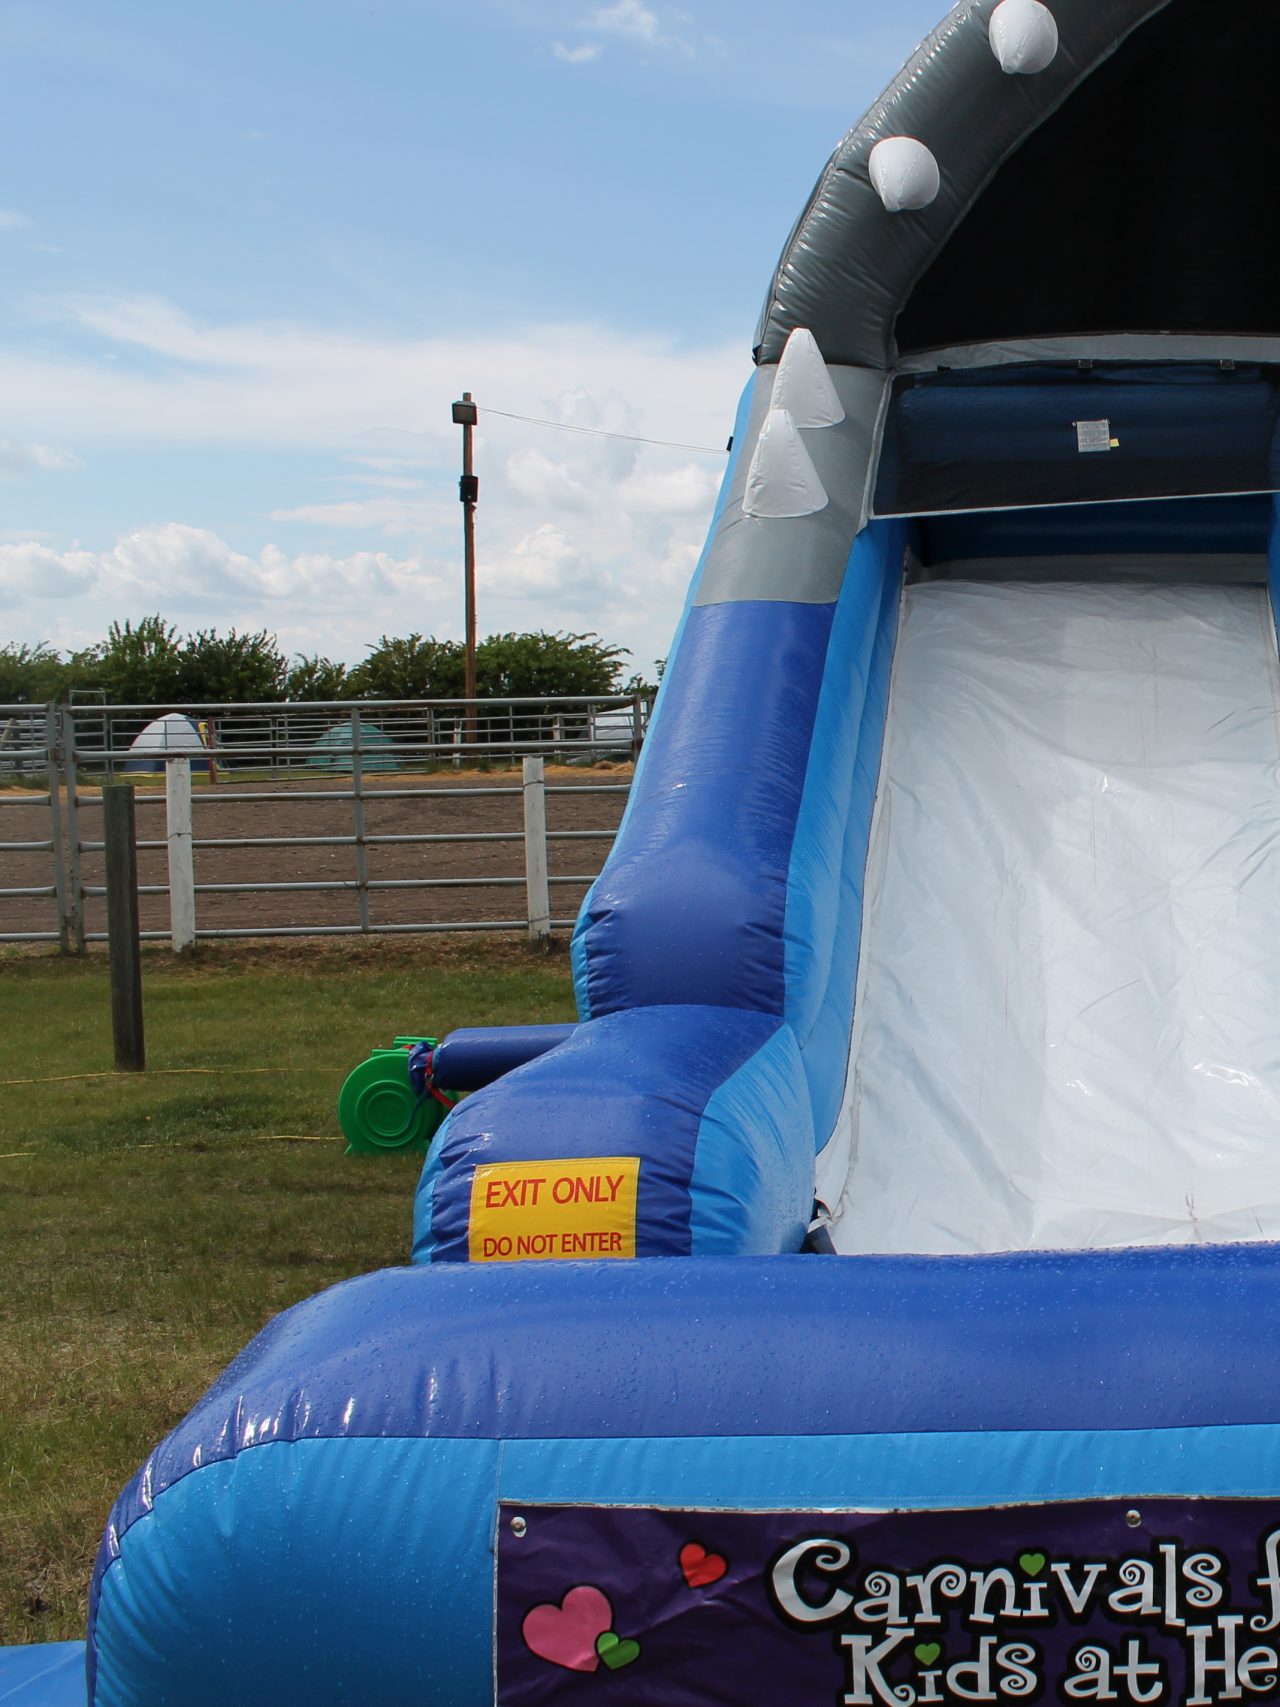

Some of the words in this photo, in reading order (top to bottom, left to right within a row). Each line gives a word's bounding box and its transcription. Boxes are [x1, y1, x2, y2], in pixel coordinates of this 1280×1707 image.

[485, 1178, 546, 1209] EXIT
[552, 1175, 625, 1204] ONLY
[483, 1236, 512, 1257] DO
[517, 1233, 557, 1255] NOT
[561, 1232, 622, 1252] ENTER
[771, 1538, 1223, 1627] Carnivals
[840, 1627, 1037, 1707] Kids
[1064, 1640, 1163, 1702] at
